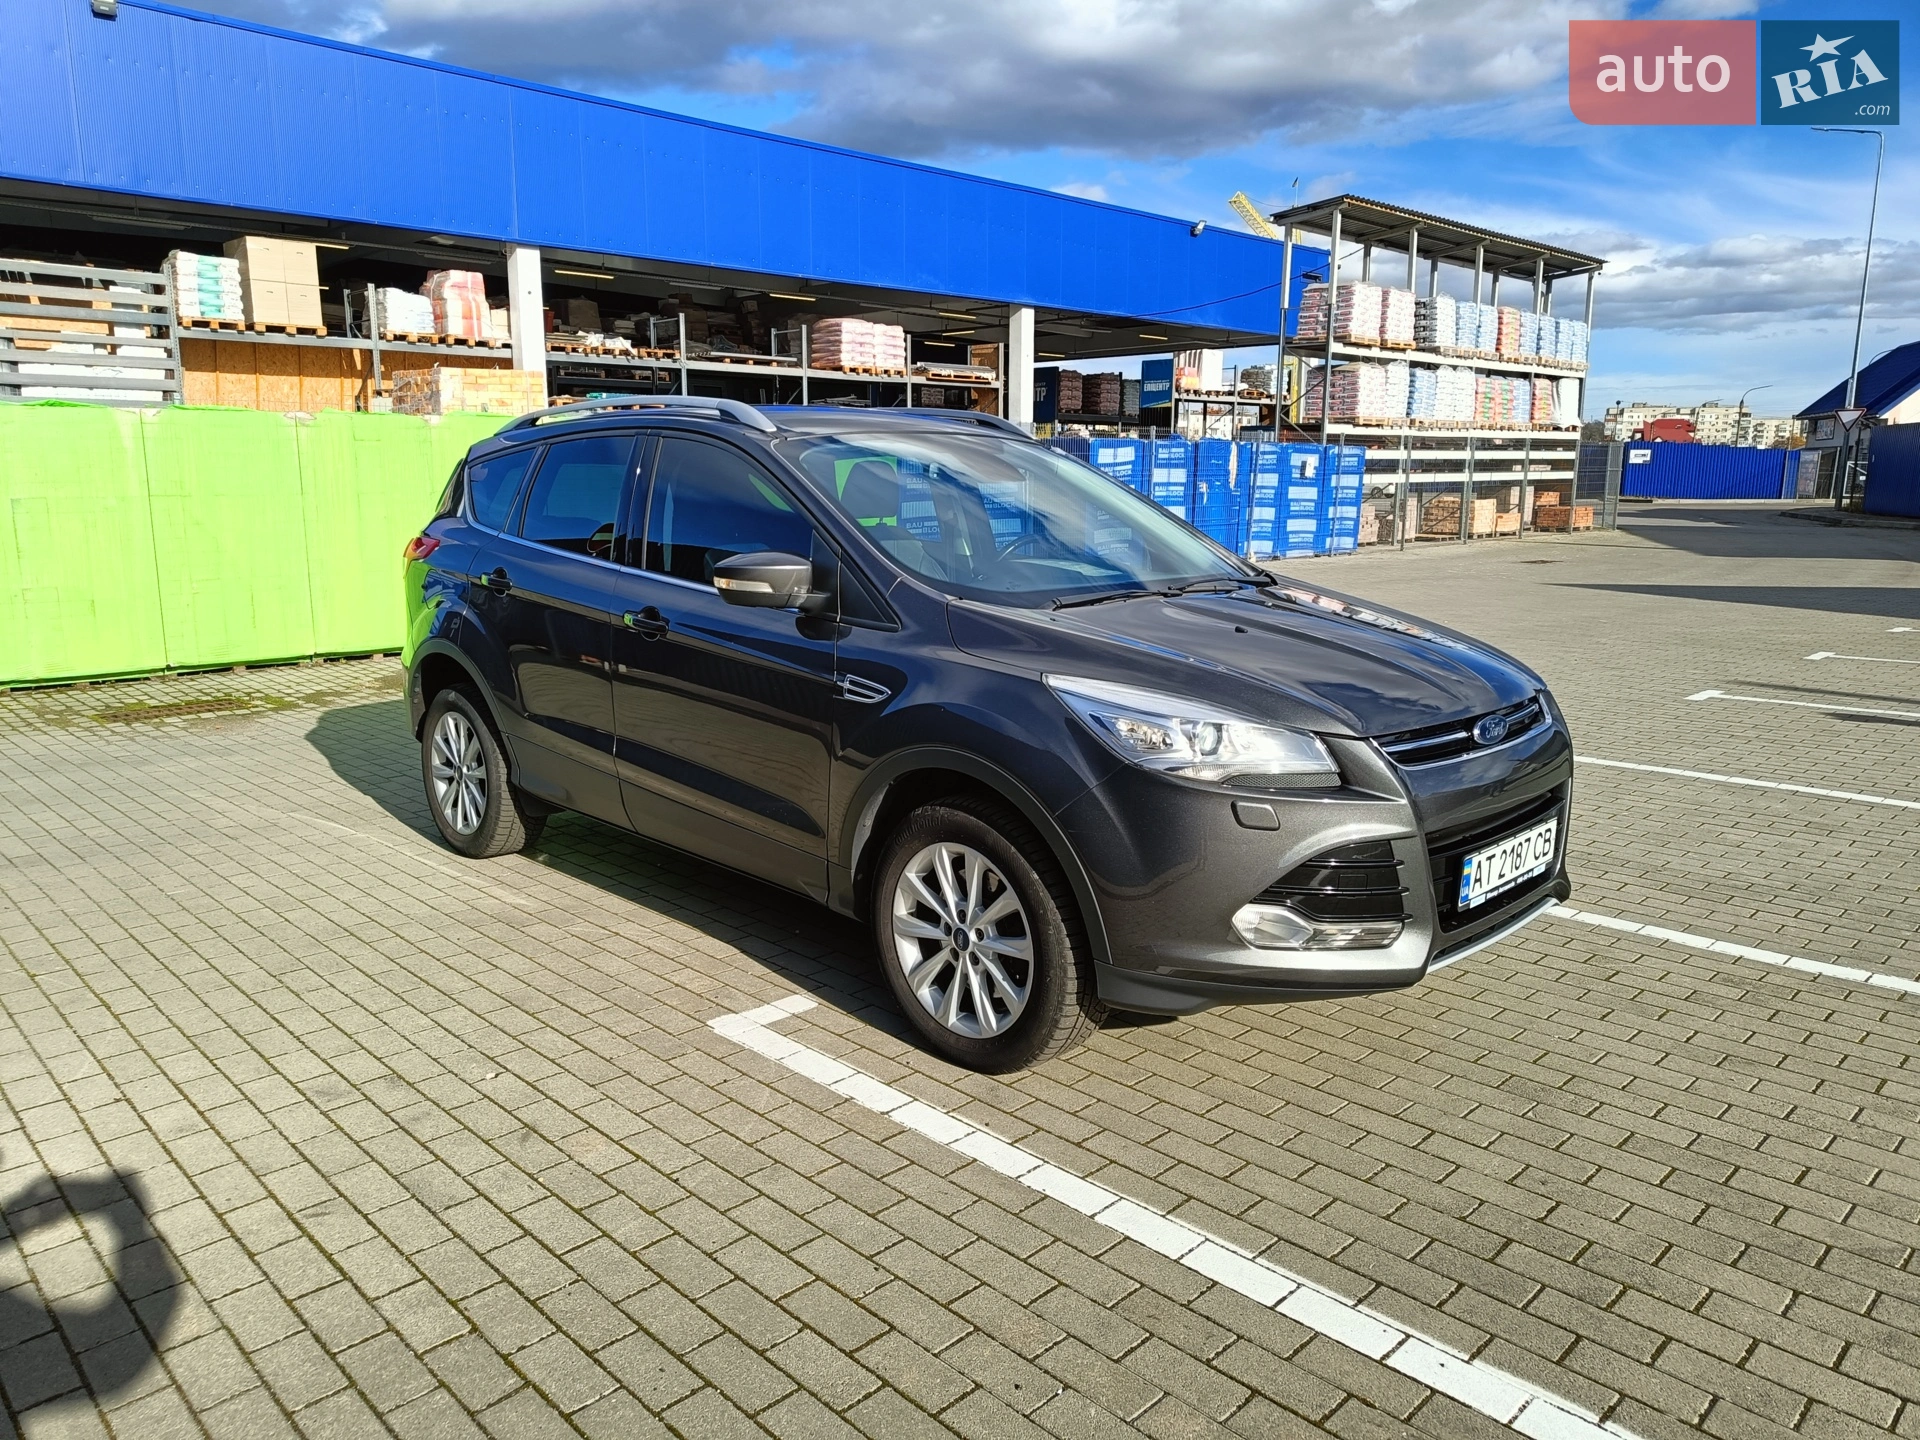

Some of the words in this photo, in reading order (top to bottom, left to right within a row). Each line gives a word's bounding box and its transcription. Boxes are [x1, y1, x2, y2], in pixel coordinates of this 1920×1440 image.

[906, 521, 923, 529] BAU
[1471, 854, 1496, 893] AT
[1497, 834, 1532, 881] 2187
[1533, 828, 1553, 861] CB
